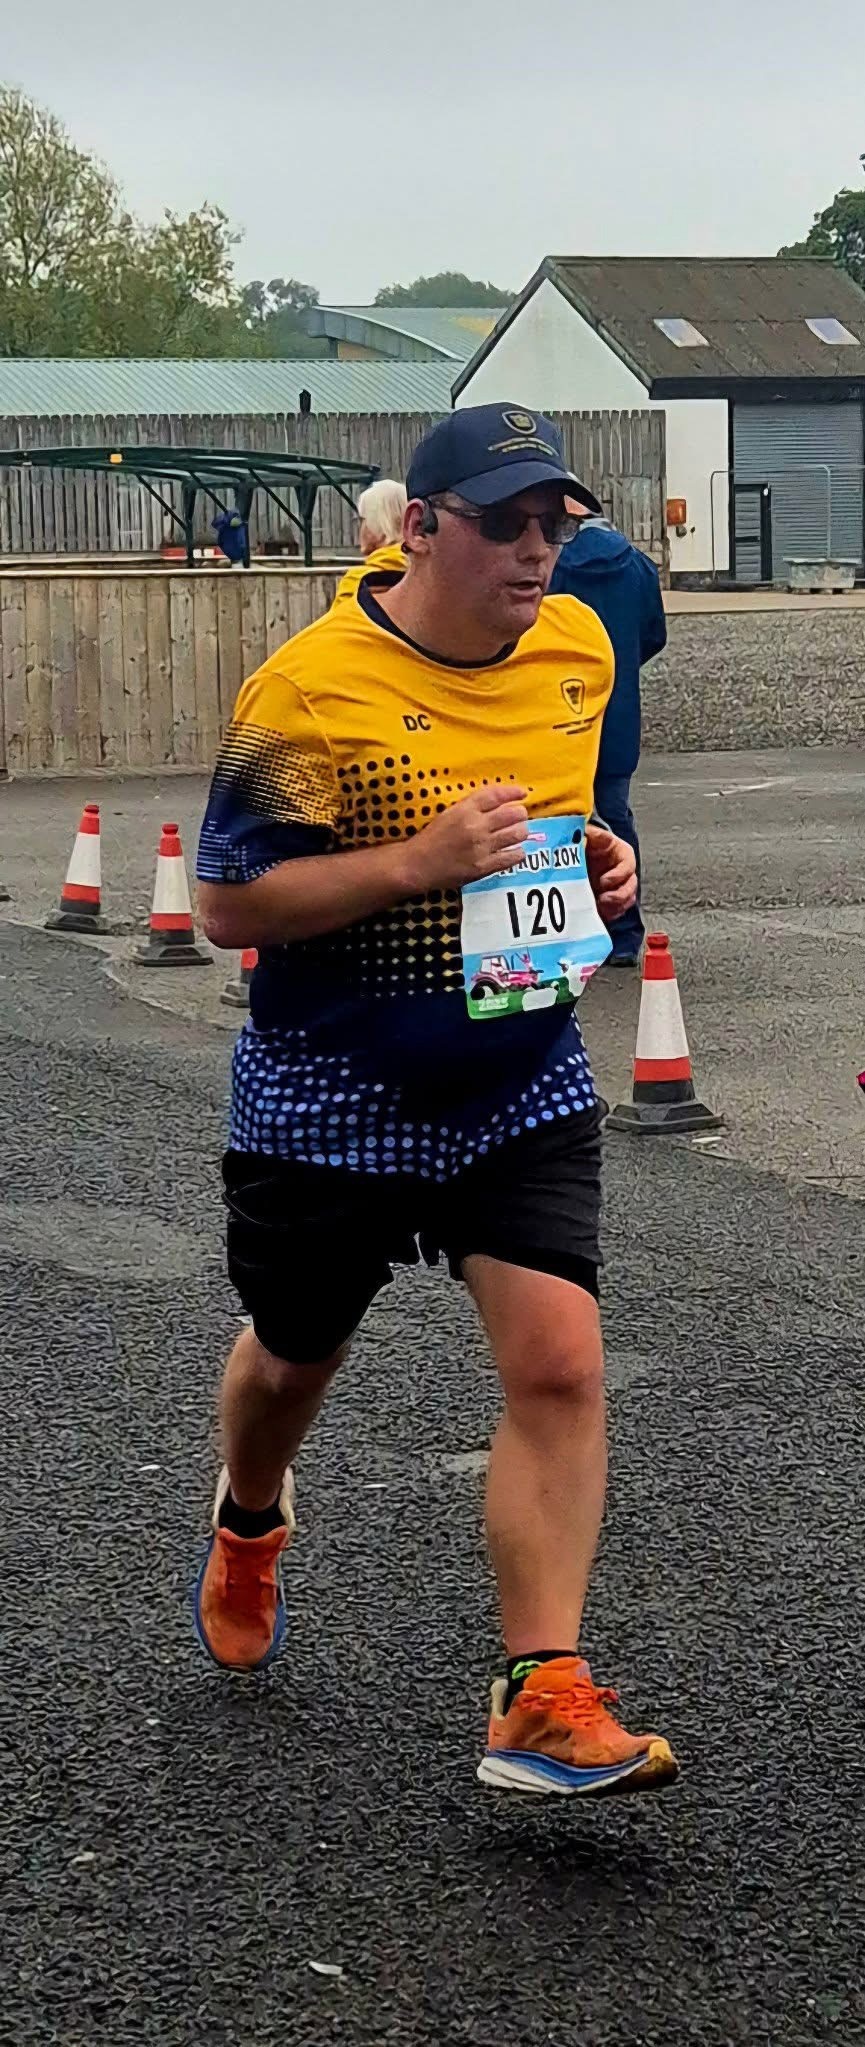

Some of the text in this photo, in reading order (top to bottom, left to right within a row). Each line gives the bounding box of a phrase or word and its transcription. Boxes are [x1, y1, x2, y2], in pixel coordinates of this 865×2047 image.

[402, 714, 431, 731] DC
[554, 847, 580, 867] 10K
[506, 886, 566, 938] 120
